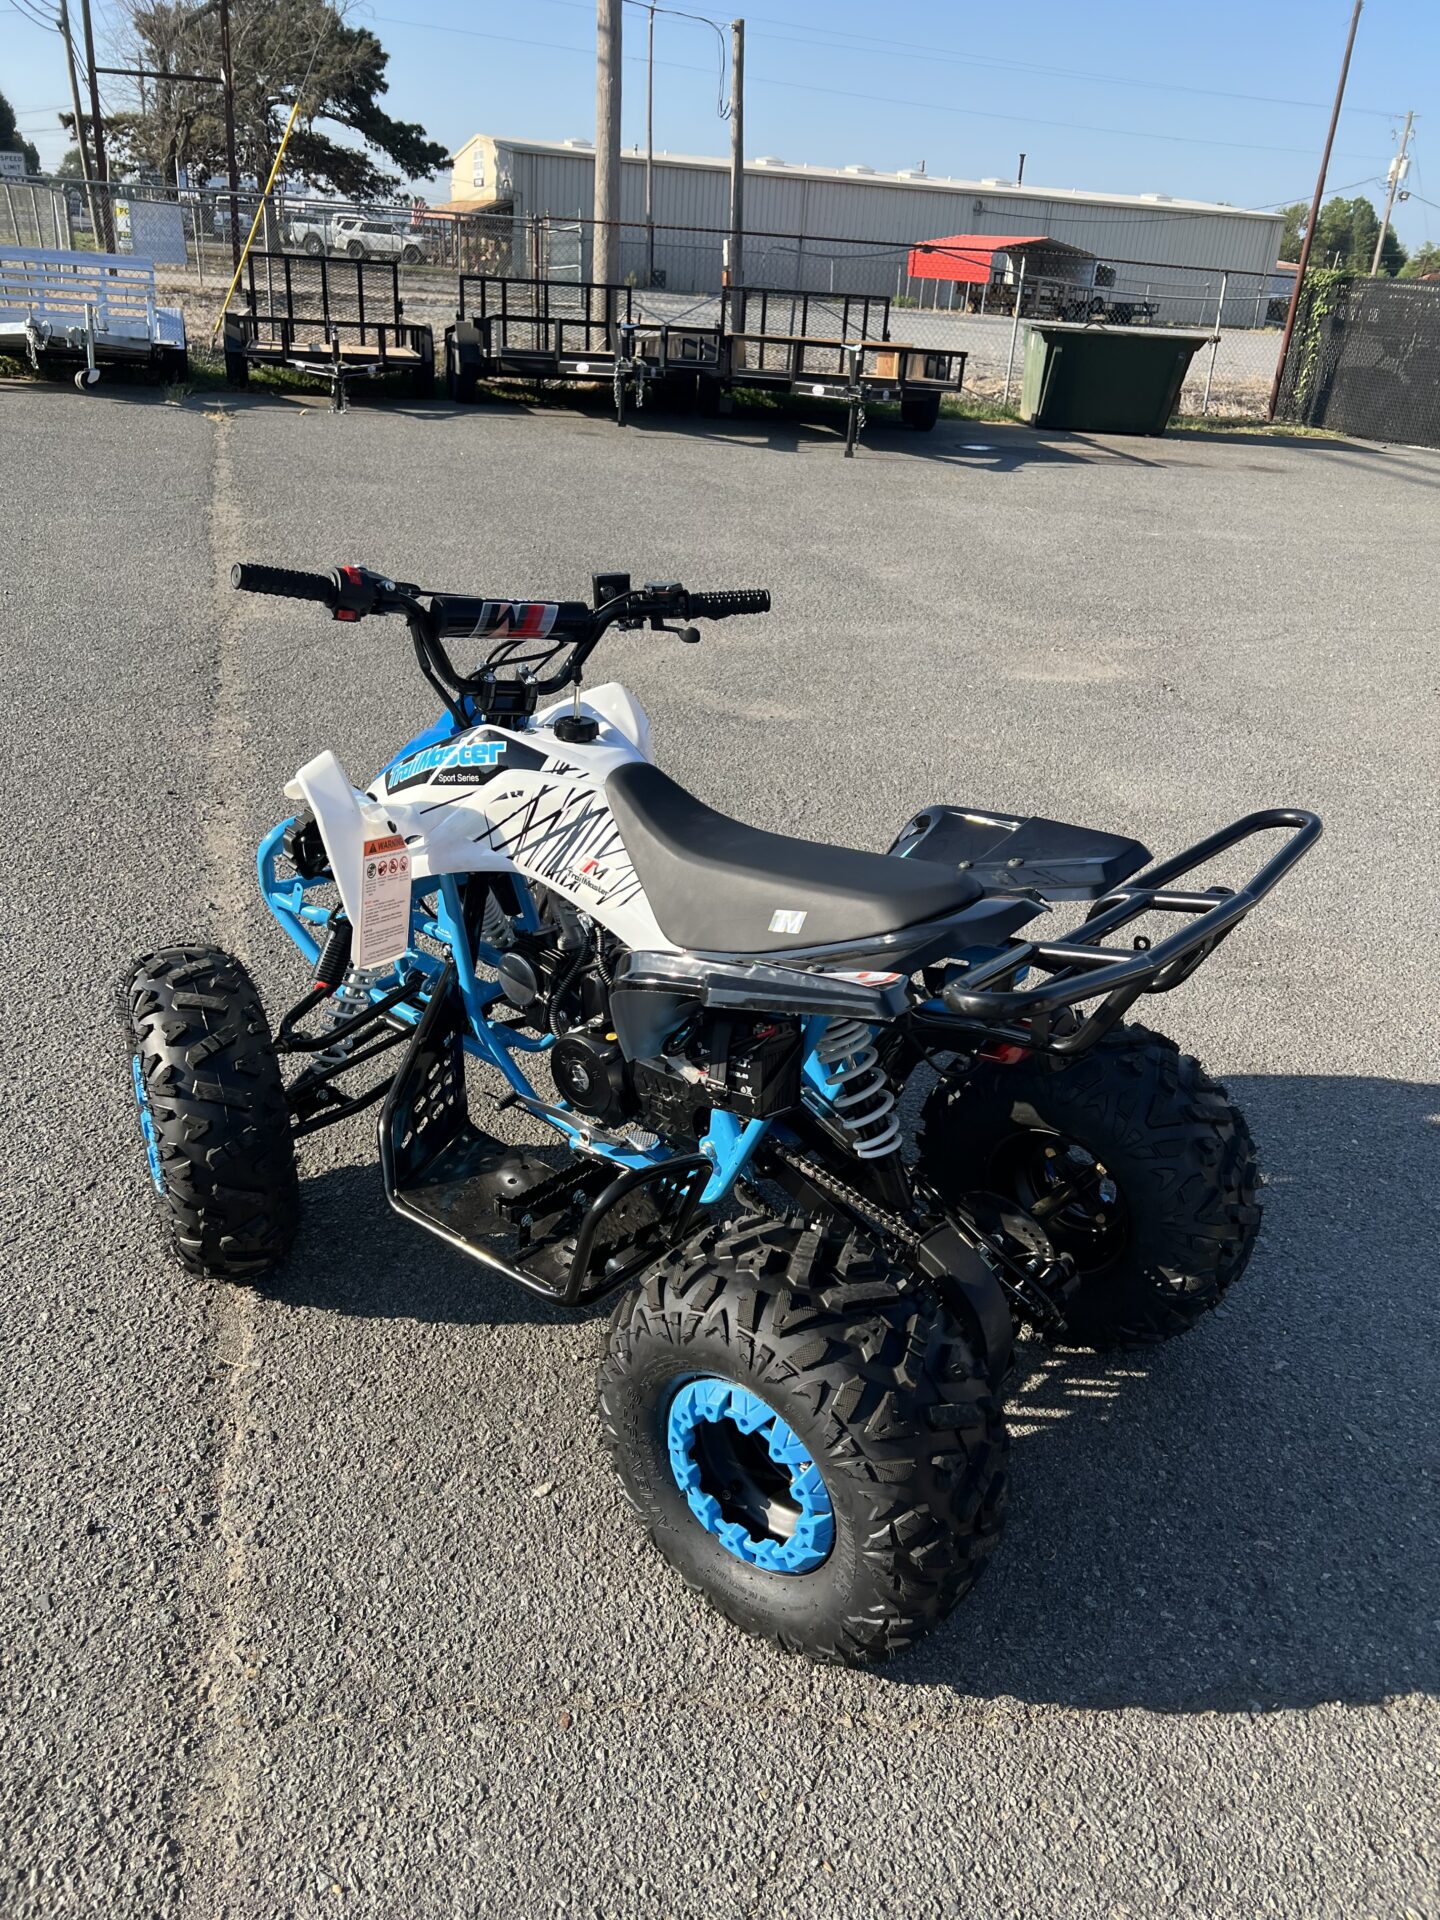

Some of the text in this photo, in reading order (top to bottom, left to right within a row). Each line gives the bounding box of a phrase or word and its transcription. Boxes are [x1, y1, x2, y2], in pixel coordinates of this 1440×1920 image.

[388, 741, 507, 789] TrailMaster
[438, 773, 480, 784] Sport Series
[567, 868, 609, 896] TrailMaster
